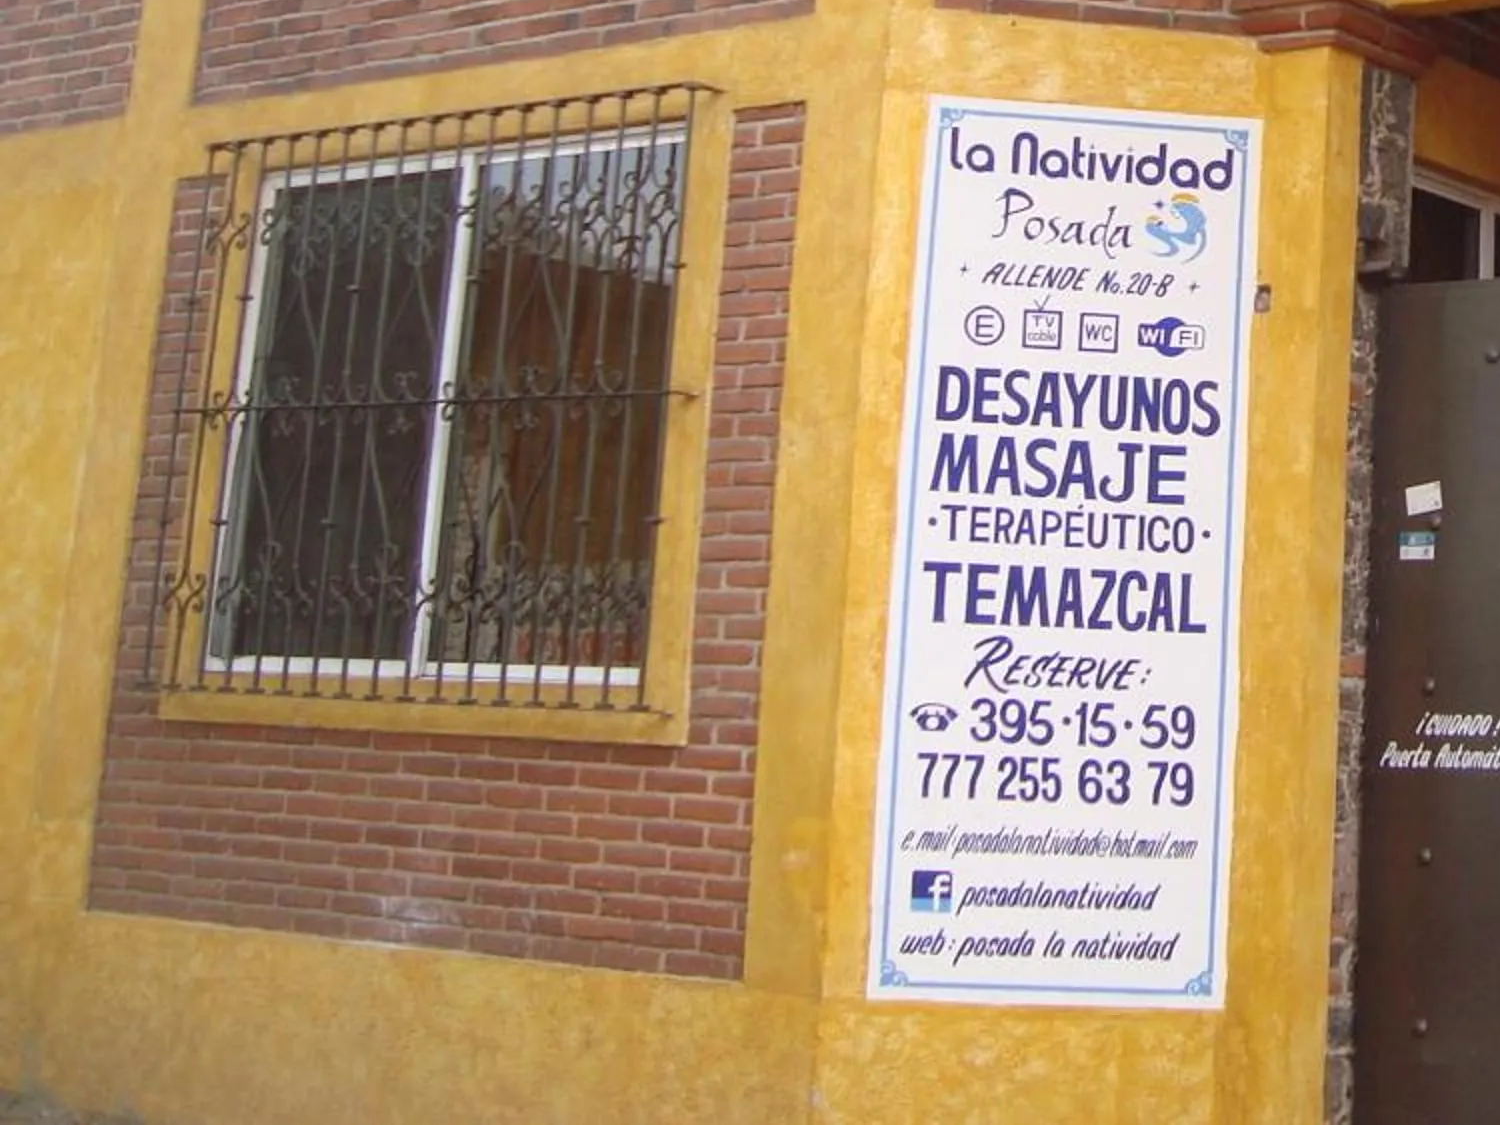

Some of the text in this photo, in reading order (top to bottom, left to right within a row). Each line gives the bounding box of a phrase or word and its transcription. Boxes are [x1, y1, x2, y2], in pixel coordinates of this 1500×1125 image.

[950, 127, 995, 173] la
[991, 187, 1133, 260] Posada
[981, 262, 1090, 291] ALLENDE
[974, 314, 994, 338] E
[1032, 315, 1055, 327] TV
[1085, 323, 1113, 342] WC
[935, 365, 1221, 437] DESAYUNOS
[929, 432, 1188, 505] MASAJE
[923, 561, 1207, 634] TEMAZCAL
[1379, 741, 1432, 768] Puerta
[917, 753, 1196, 807] 777 255 63 79
[956, 880, 1161, 916] posadalanatividad
[952, 929, 1036, 967] posada
[1043, 931, 1066, 957] la
[1072, 932, 1181, 961] natividad
